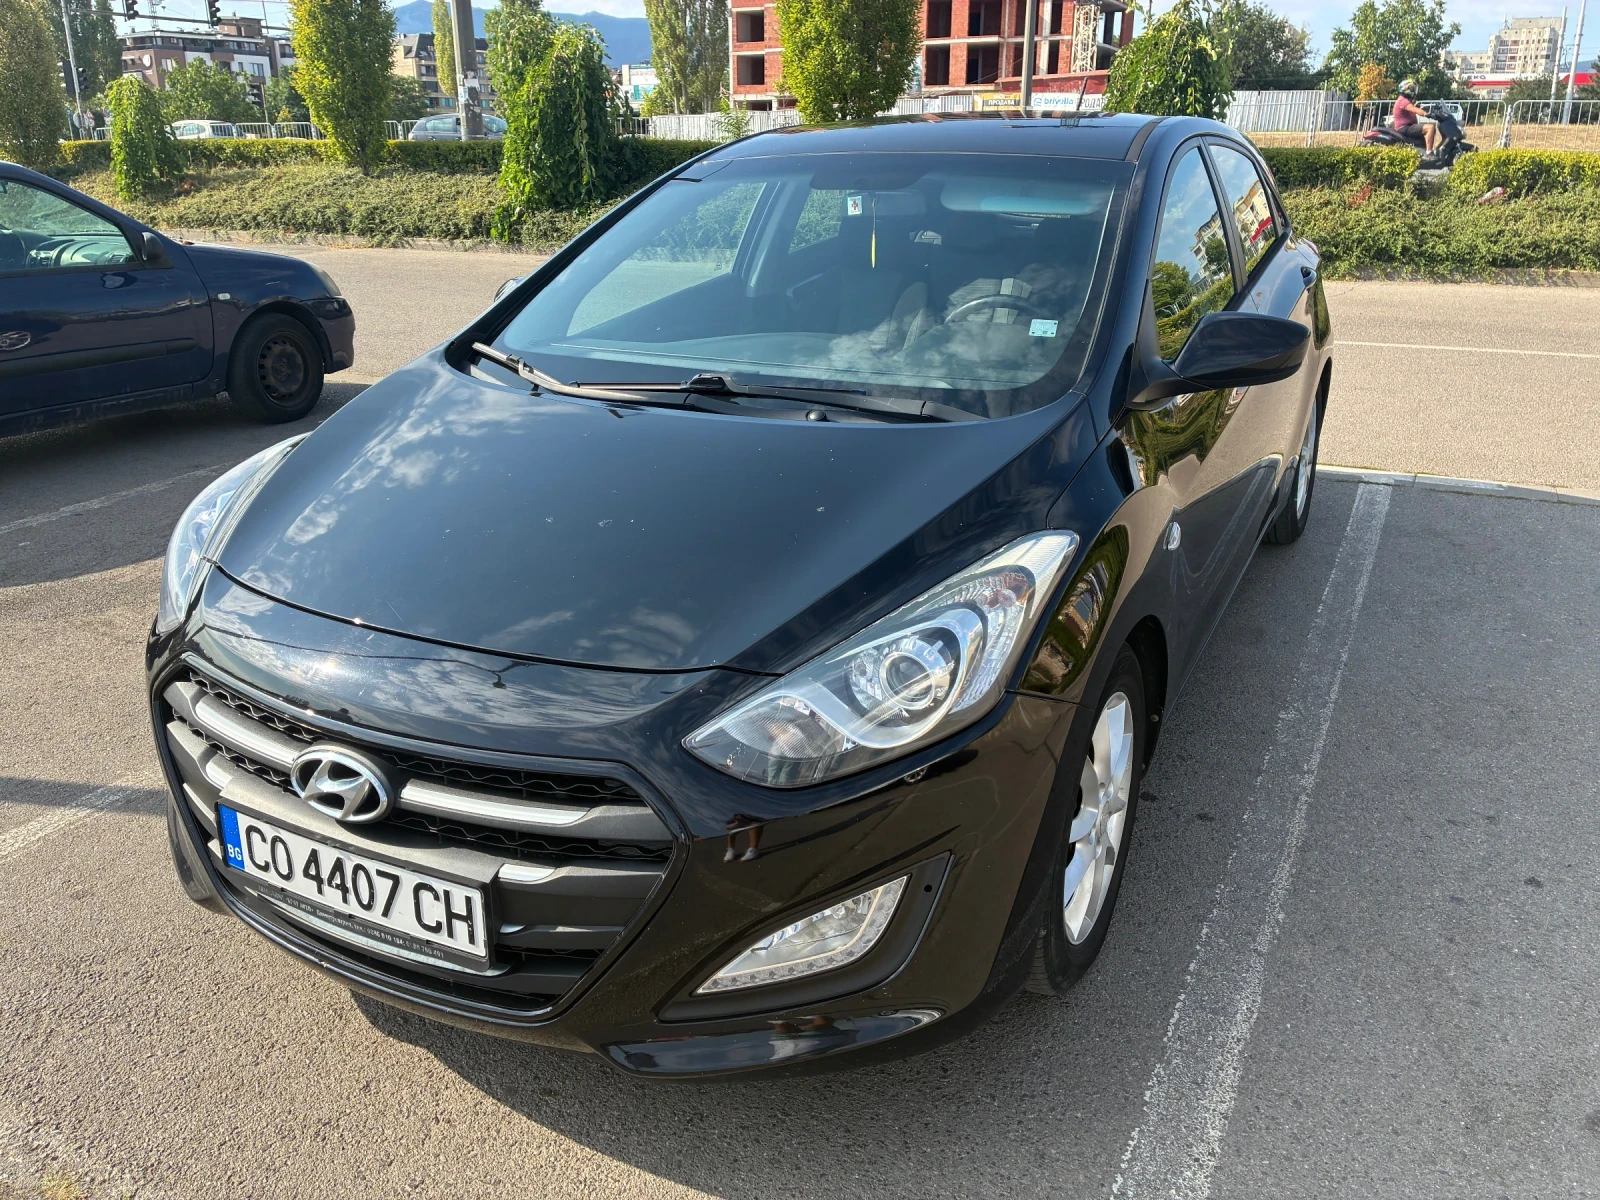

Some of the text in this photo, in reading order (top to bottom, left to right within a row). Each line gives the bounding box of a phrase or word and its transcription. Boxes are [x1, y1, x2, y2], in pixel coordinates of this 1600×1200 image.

[227, 843, 242, 861] BG
[245, 824, 476, 946] CO 4407 CH
